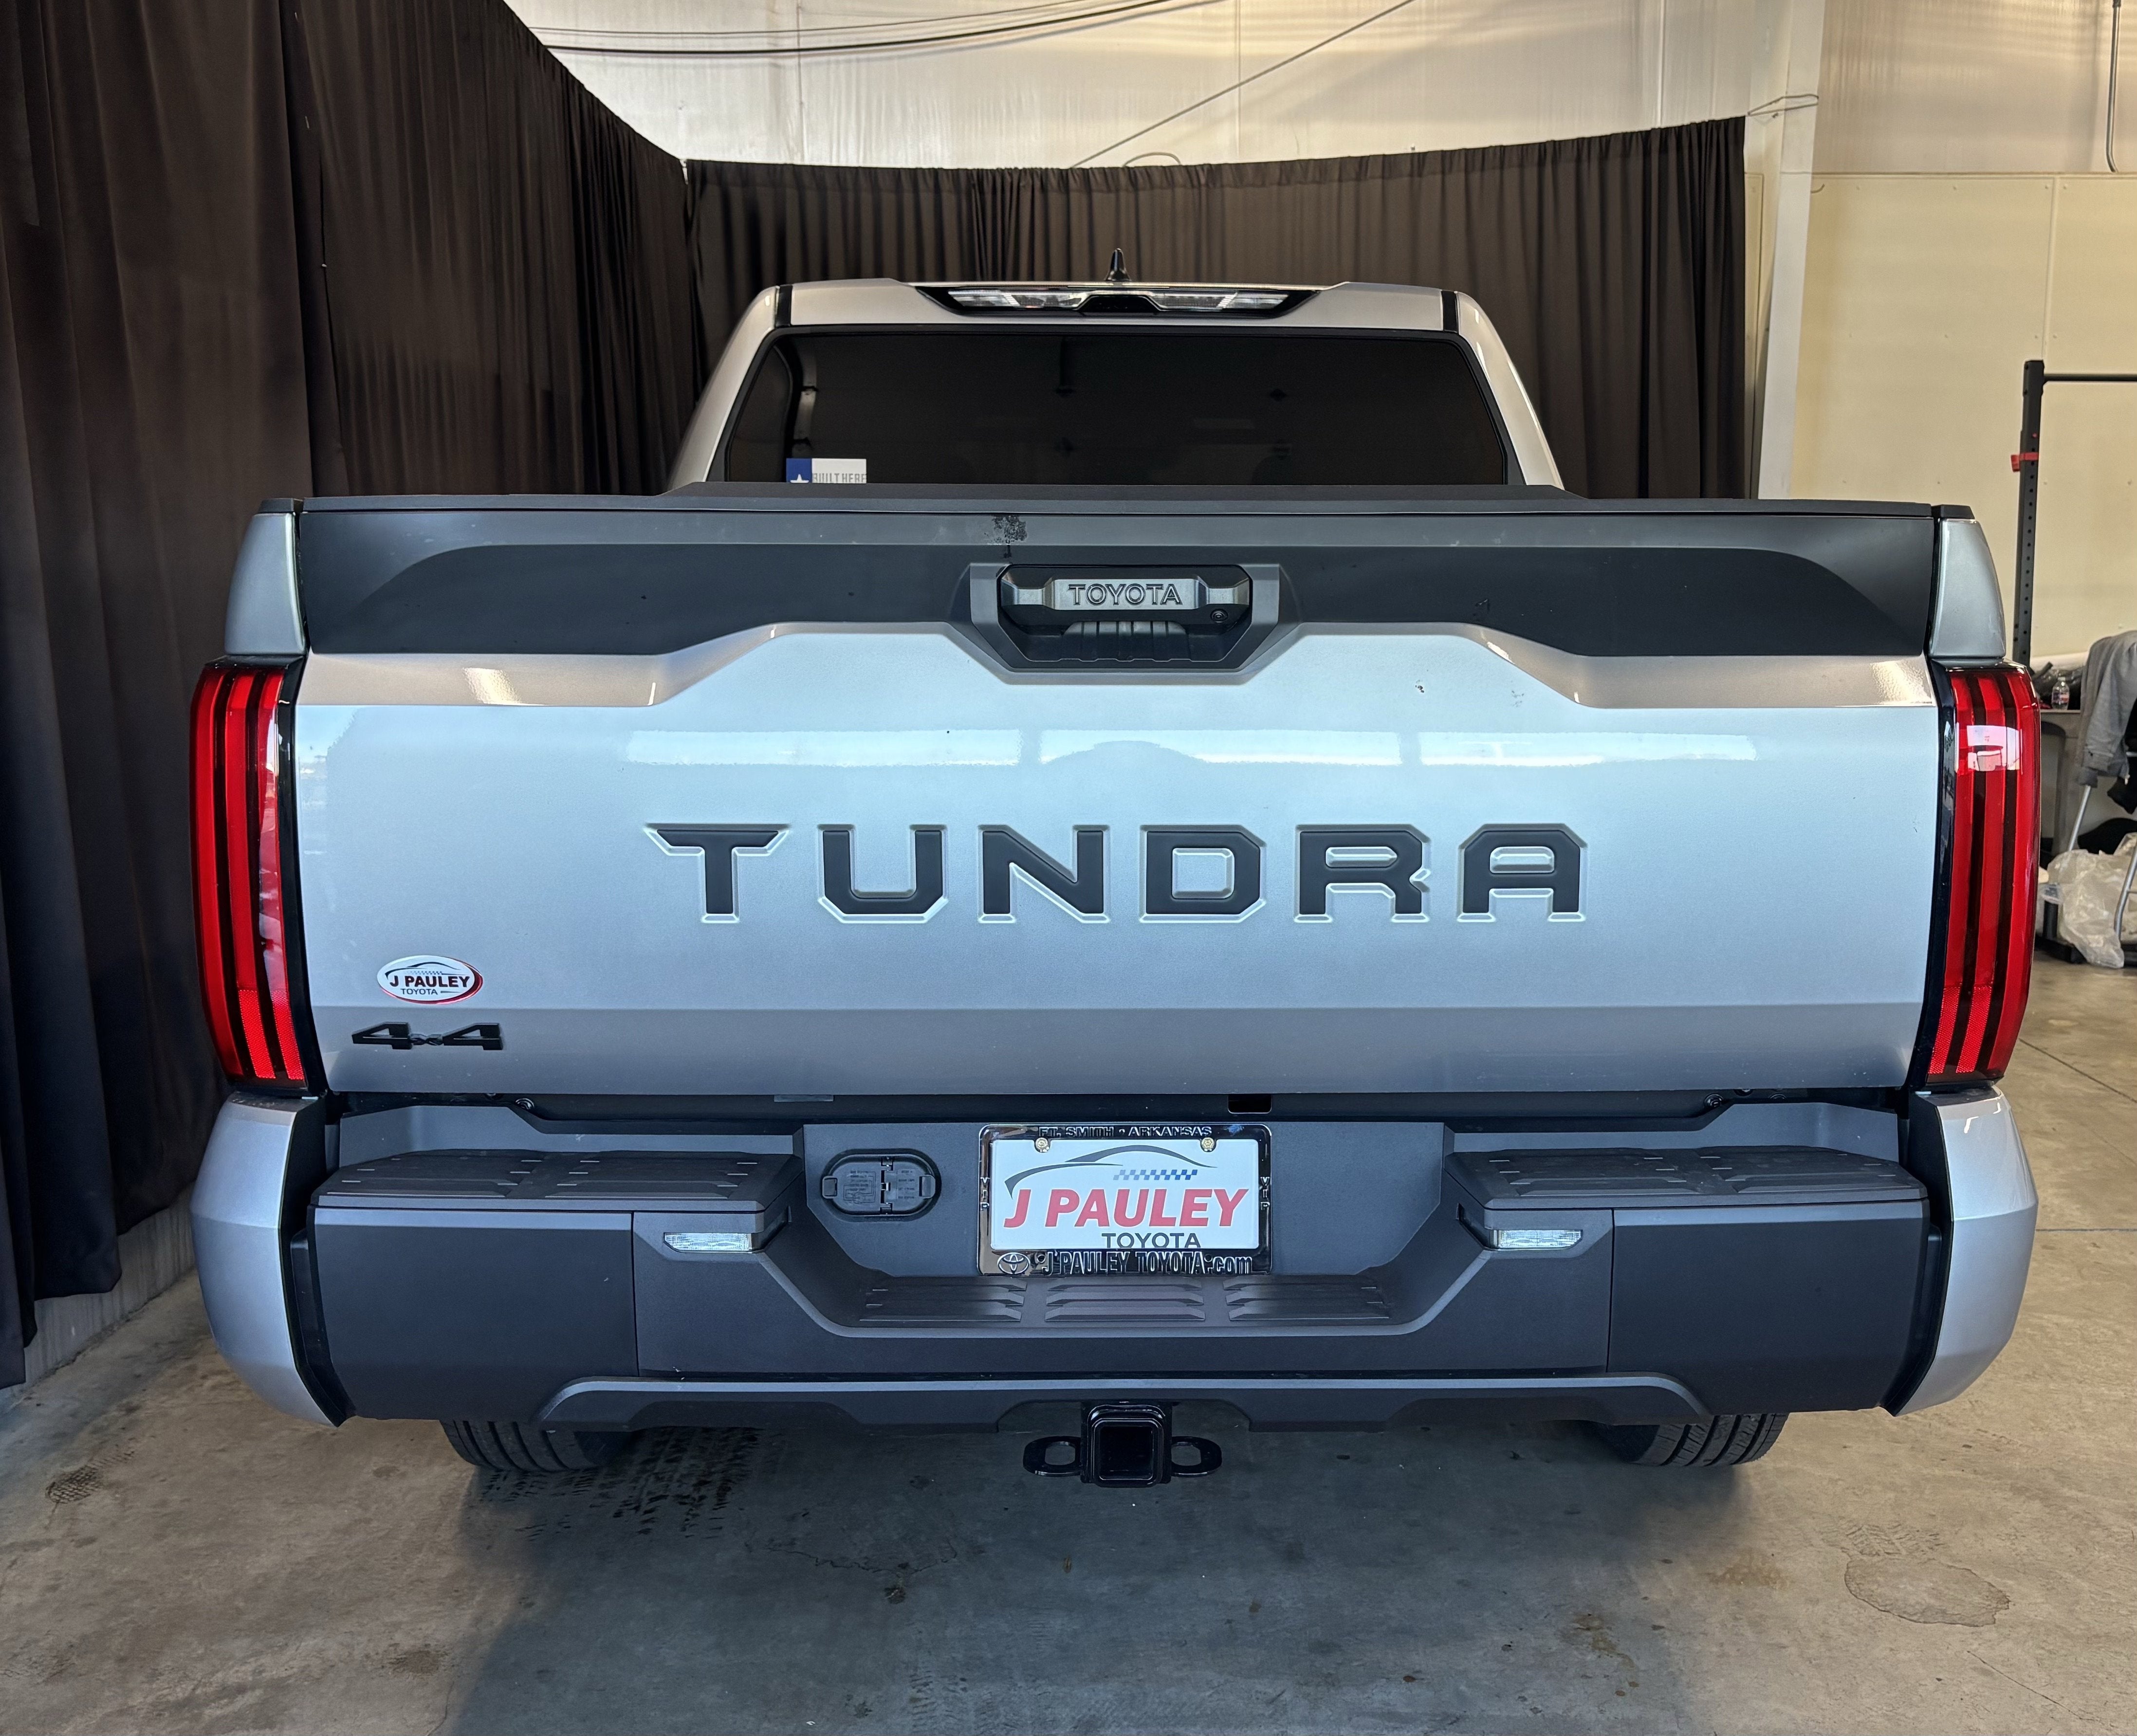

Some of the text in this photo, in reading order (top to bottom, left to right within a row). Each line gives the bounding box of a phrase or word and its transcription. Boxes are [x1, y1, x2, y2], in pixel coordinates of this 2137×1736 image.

[842, 473, 866, 483] HERE
[1068, 584, 1183, 605] TOYOTA
[646, 823, 1586, 923] TUNDRA
[389, 975, 470, 987] J PAULEY
[1066, 1127, 1114, 1137] SMITH
[1128, 1126, 1212, 1136] ARKANSAS
[1004, 1189, 1249, 1227] J PAULEY
[1102, 1232, 1201, 1248] TOYOTA
[1041, 1251, 1253, 1275] J PAULEY TOYOTA.com
